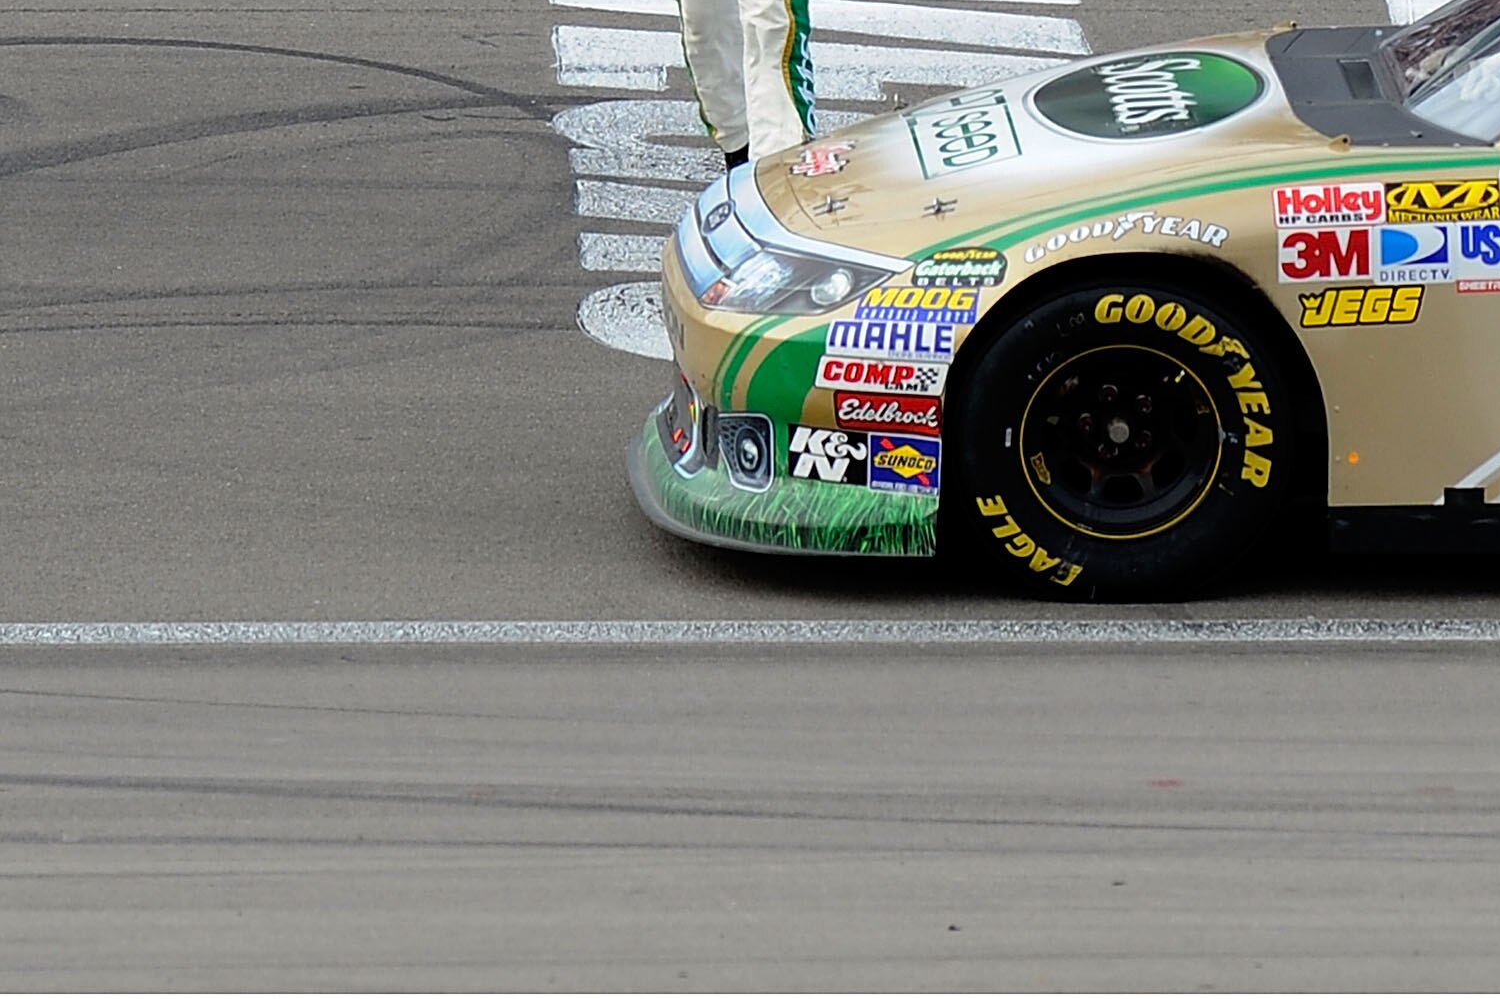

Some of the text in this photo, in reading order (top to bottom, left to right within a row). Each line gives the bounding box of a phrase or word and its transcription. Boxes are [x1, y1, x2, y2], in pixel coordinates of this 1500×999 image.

[1098, 57, 1202, 126] Scotts
[1278, 186, 1382, 221] Holley
[1280, 213, 1364, 225] HP CARBS
[1388, 206, 1500, 223] MECHANIX WEAR
[1024, 210, 1230, 264] GOODYEAR
[914, 259, 1003, 277] Gatorback
[1281, 229, 1370, 279] 3M
[917, 277, 996, 287] BELTS
[1380, 269, 1451, 282] DIRECTV
[861, 287, 978, 310] MOOG
[1301, 288, 1423, 327] JEGS
[828, 321, 953, 354] MAHLE
[823, 360, 915, 386] COMP
[1094, 294, 1274, 488] GOODYEAR
[838, 397, 938, 428] Edelbrock
[877, 454, 934, 472] SUNOCO
[976, 495, 1084, 587] EAGLE
